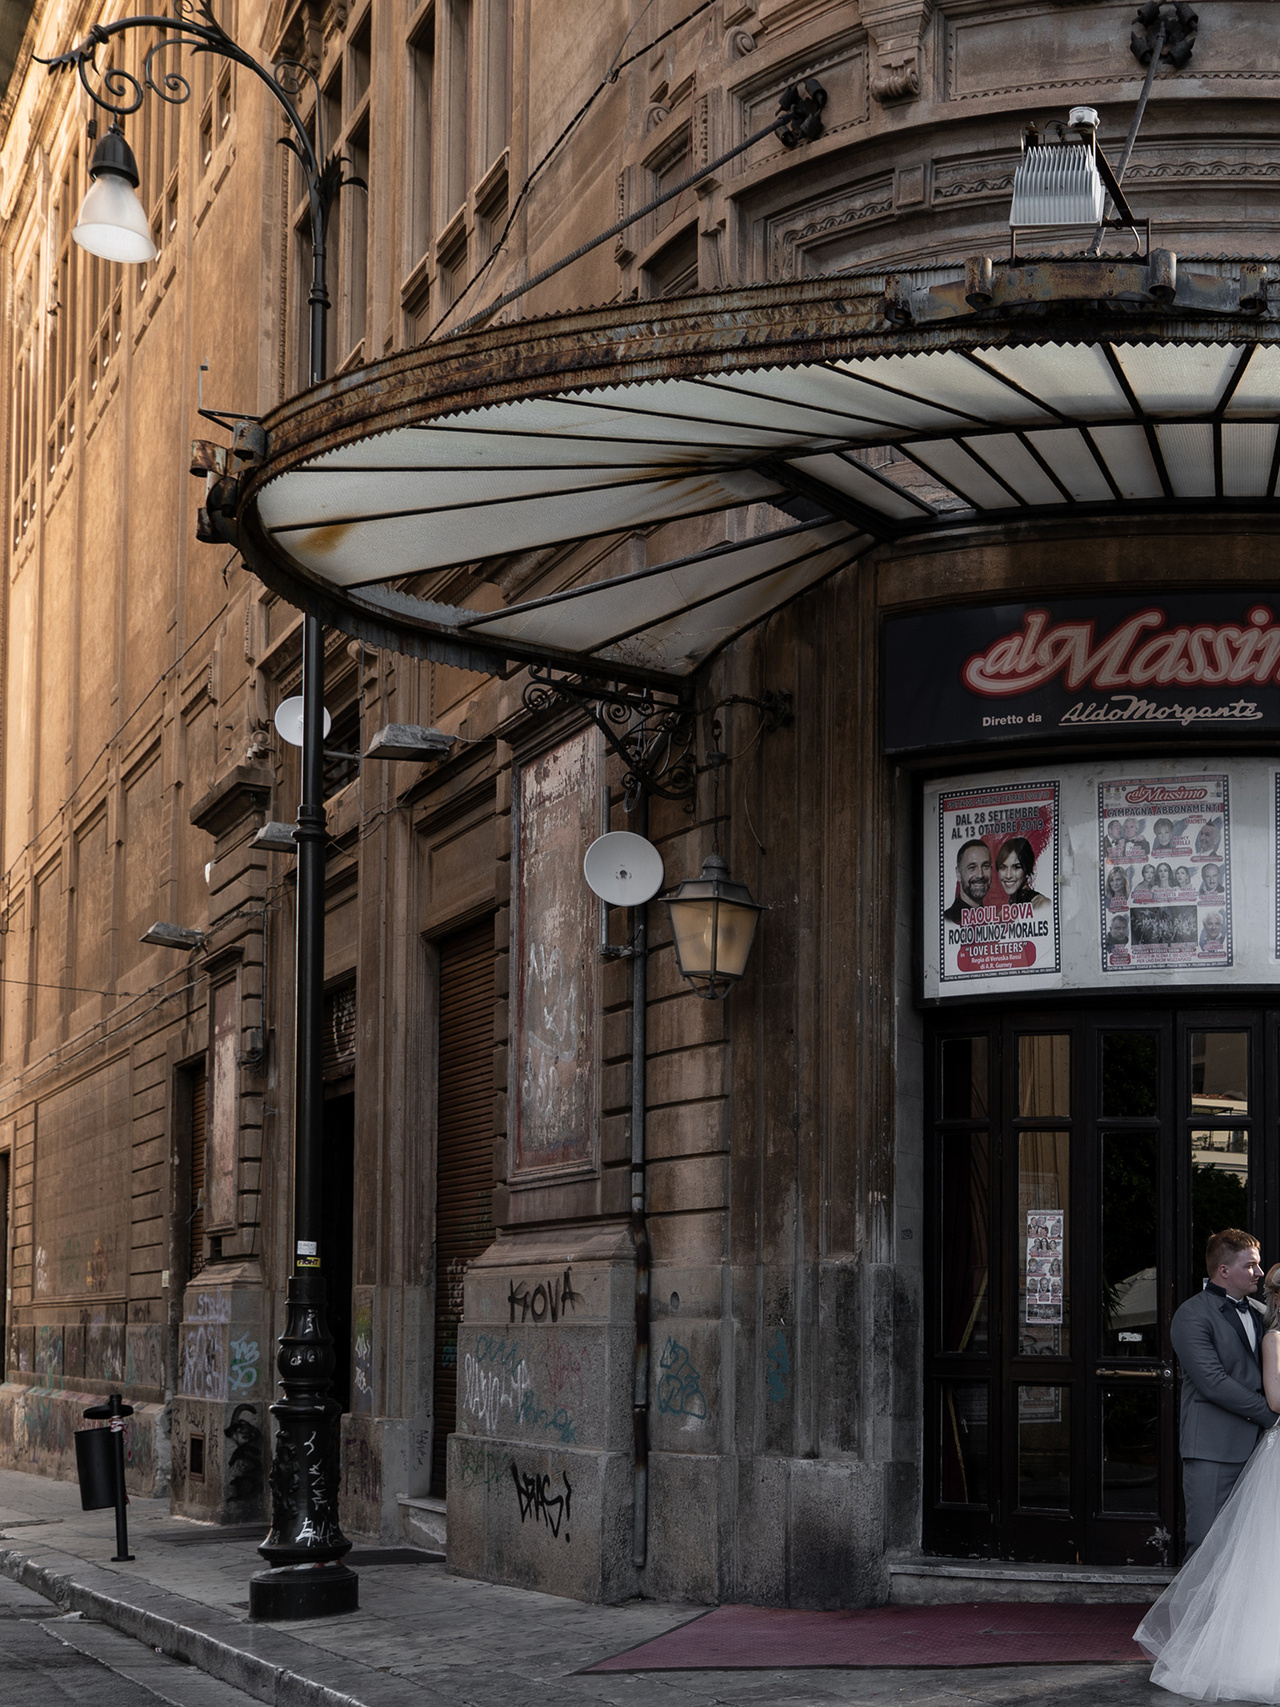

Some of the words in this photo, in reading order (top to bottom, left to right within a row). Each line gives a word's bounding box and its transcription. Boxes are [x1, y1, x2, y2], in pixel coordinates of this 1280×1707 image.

[981, 714, 1025, 728] Diretto
[1027, 712, 1043, 724] da
[947, 799, 975, 810] SPETTACOLI
[975, 797, 1000, 806] STAGIONE
[1001, 794, 1025, 803] TEATRALE
[1026, 791, 1049, 800] 2018/19
[1106, 806, 1153, 817] CAMPAGNA
[1156, 803, 1220, 815] ABBONAMENTI
[955, 813, 972, 827] DAL
[974, 812, 986, 823] 28
[988, 806, 1039, 822] SETTEMBRE
[951, 828, 962, 840] AL
[965, 827, 975, 838] 13
[978, 821, 1017, 836] OTTOBRE
[1020, 819, 1044, 831] 2019
[961, 906, 999, 925] RAOUL
[1001, 902, 1033, 922] BOVA
[1008, 920, 1049, 939] MORALES
[508, 1266, 588, 1324] KOVA
